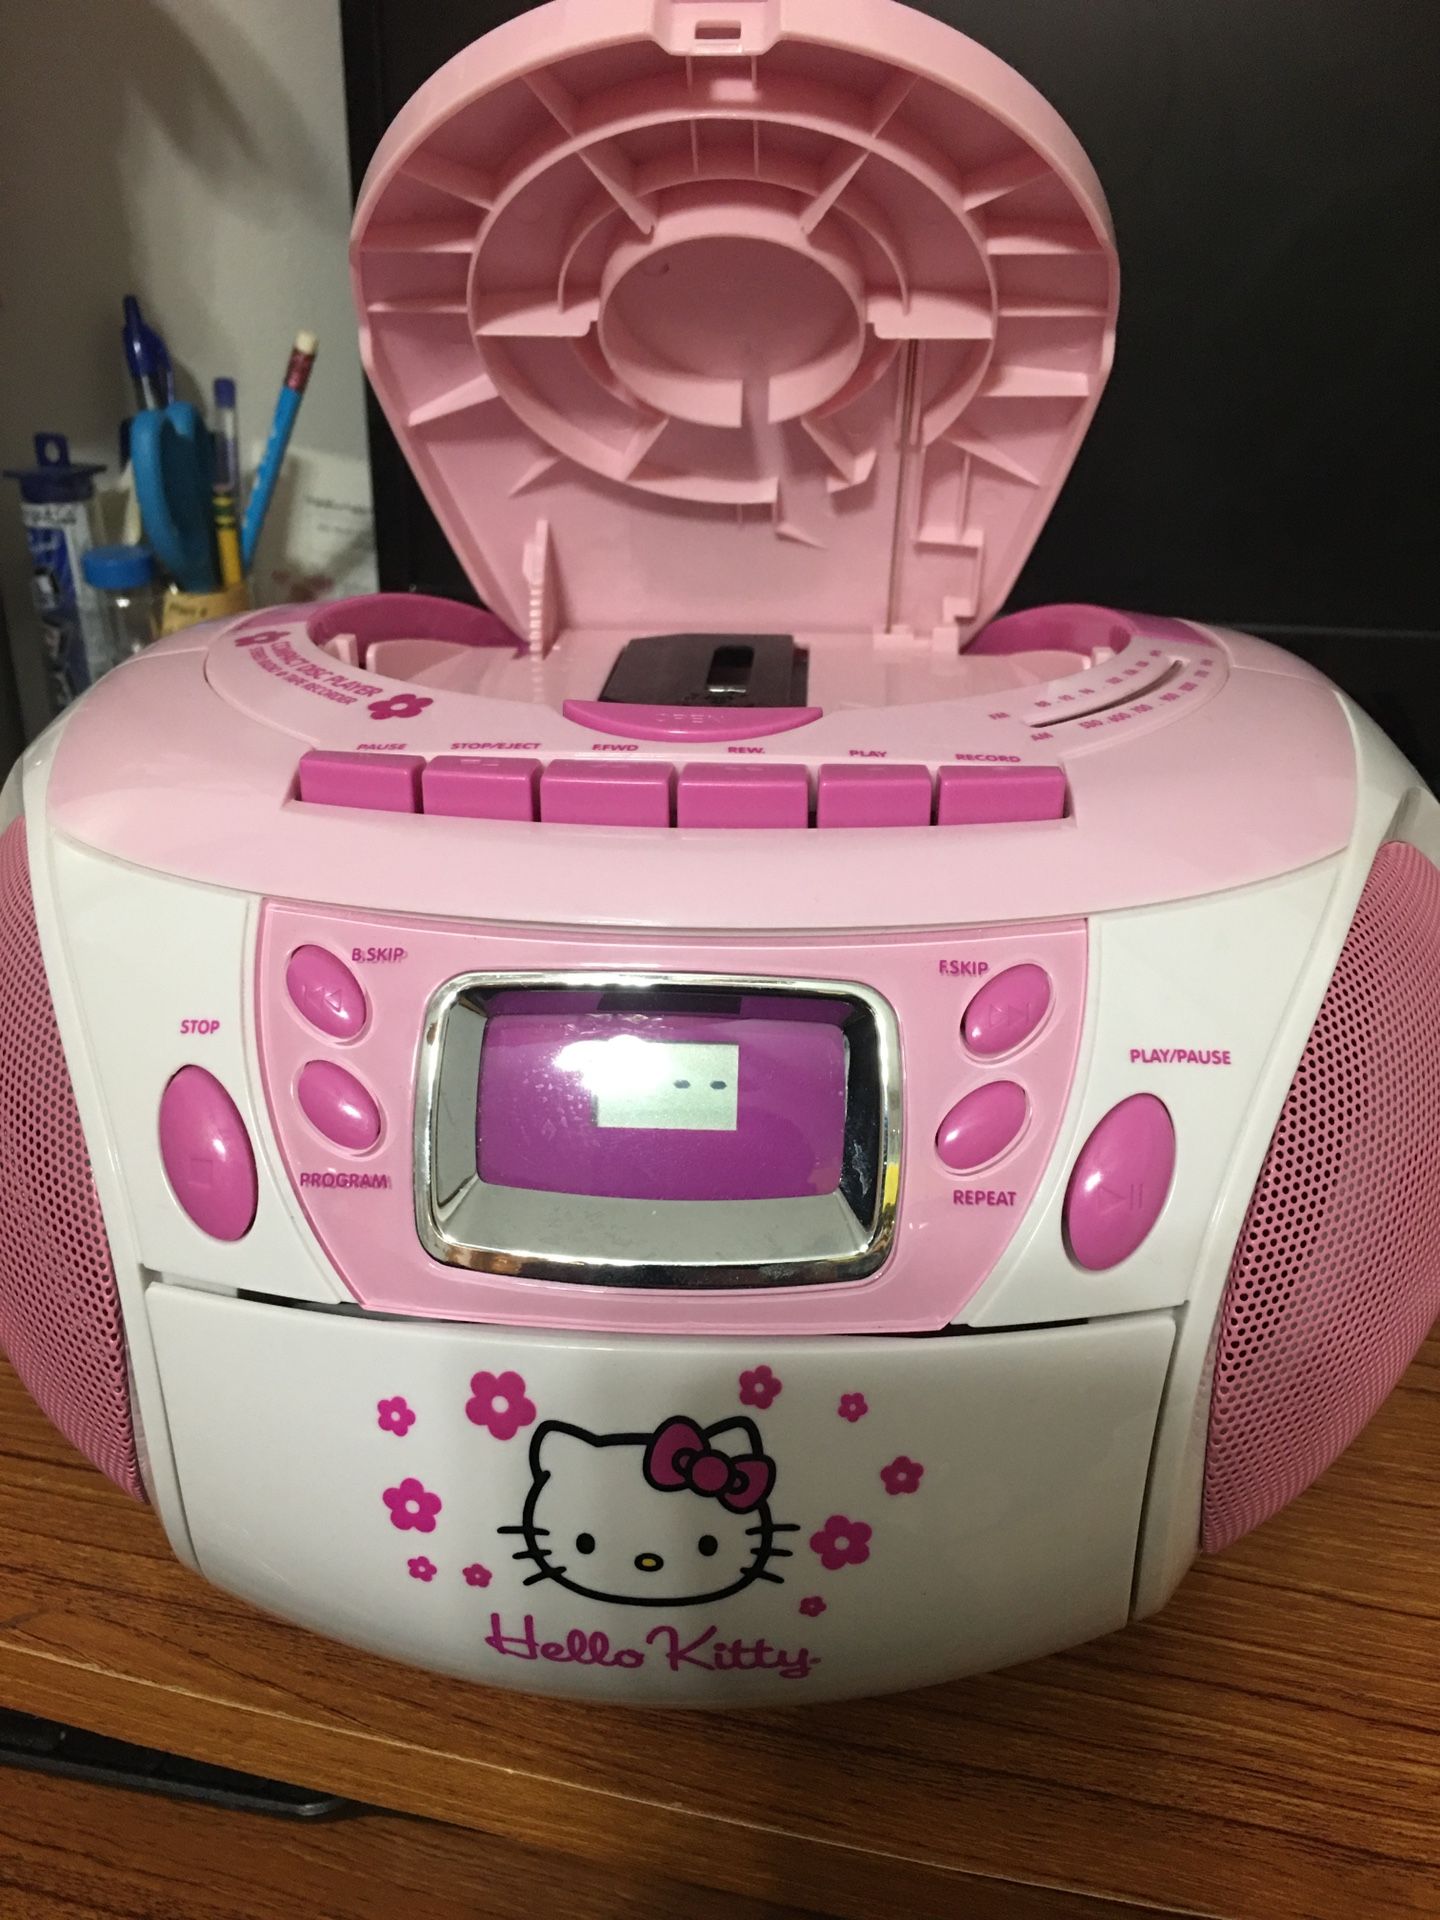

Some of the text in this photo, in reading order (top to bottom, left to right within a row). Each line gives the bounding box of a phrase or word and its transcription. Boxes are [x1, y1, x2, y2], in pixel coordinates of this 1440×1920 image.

[295, 663, 334, 680] DISC
[323, 675, 383, 697] PLAYER
[302, 682, 358, 705] RECORDER
[1030, 732, 1054, 741] AM
[450, 742, 542, 750] STOP/EJECT
[849, 750, 887, 758] PLAY
[955, 753, 1021, 763] RECORD
[351, 947, 405, 964] B.SKIP
[939, 960, 989, 976] F.SKIP
[180, 1019, 220, 1035] STOP
[1130, 1048, 1232, 1065] PLAY/PAUSE
[299, 1172, 390, 1189] PROGRAM
[953, 1190, 1016, 1206] REPEAT
[485, 1612, 810, 1679] Hello Kitty
